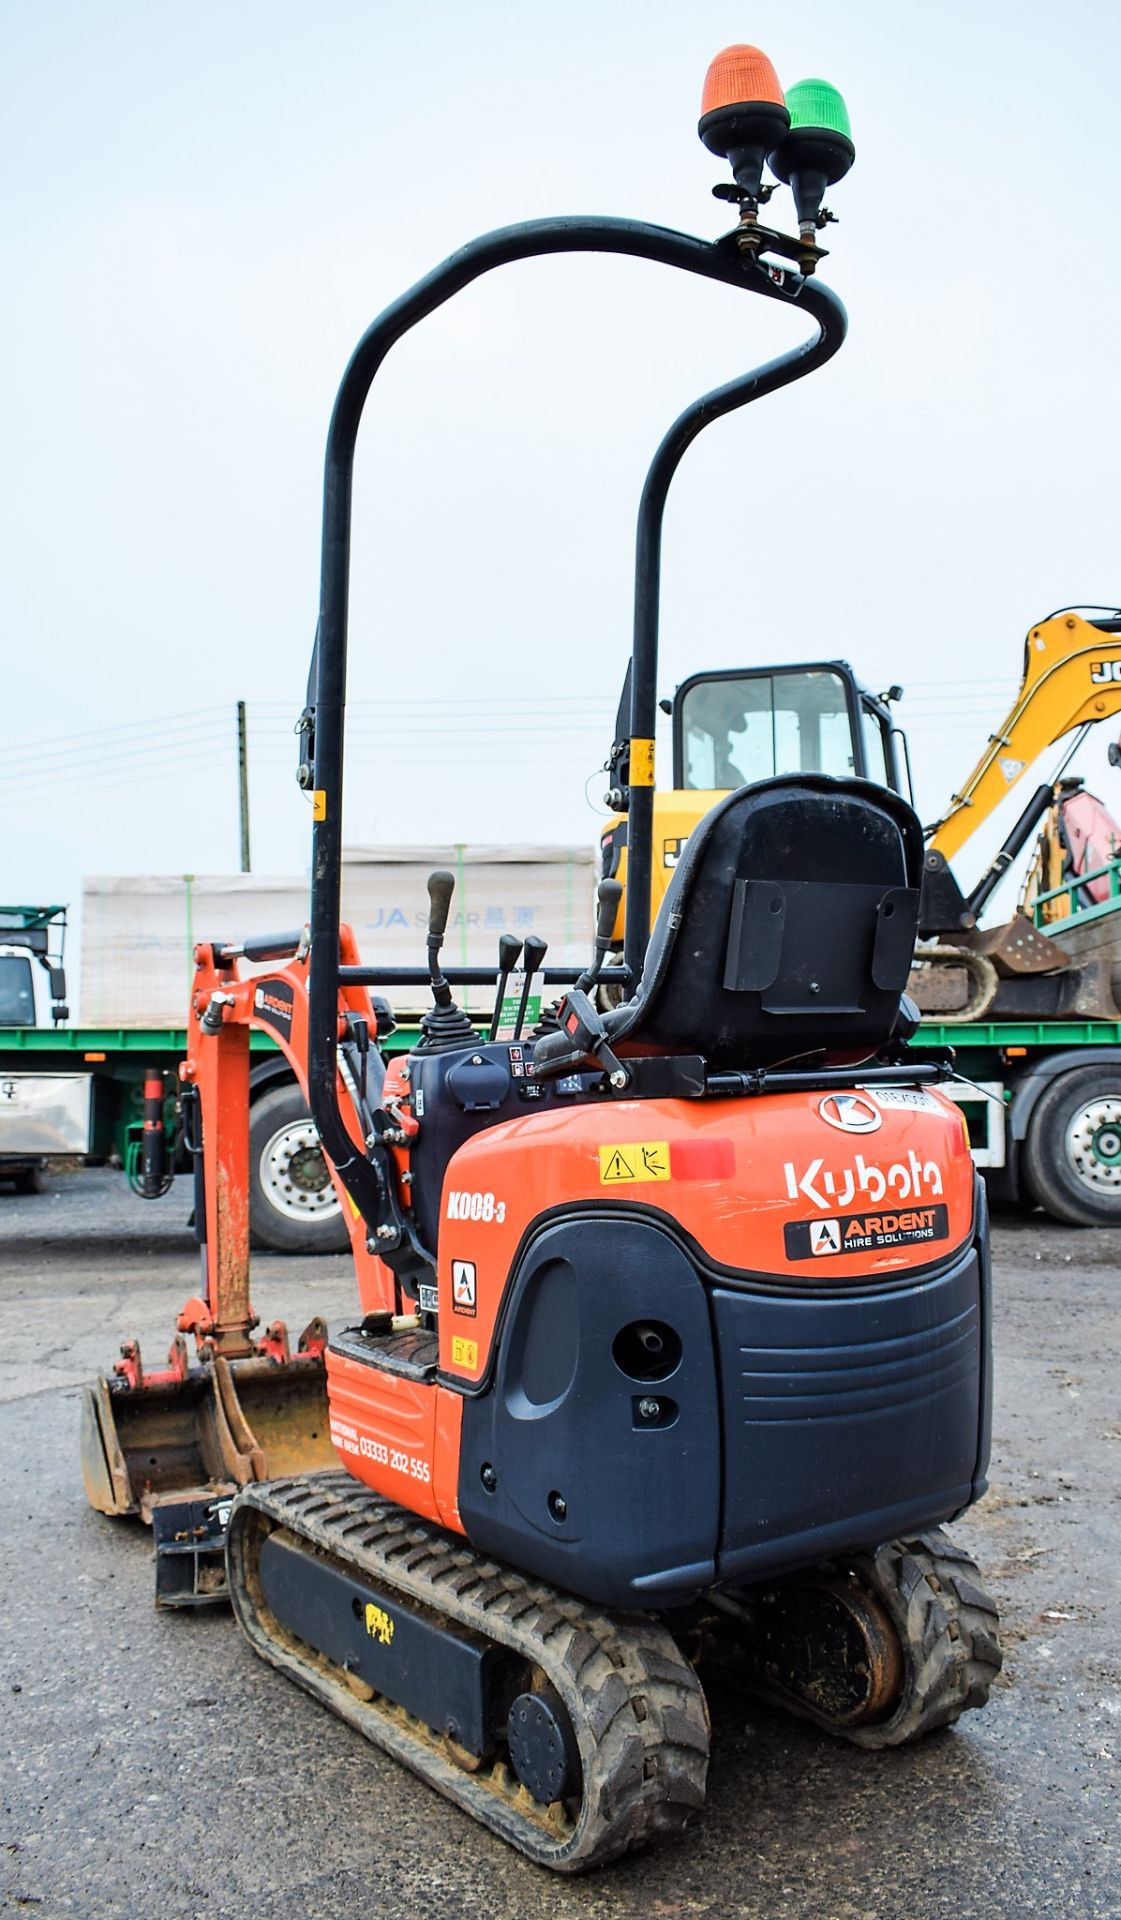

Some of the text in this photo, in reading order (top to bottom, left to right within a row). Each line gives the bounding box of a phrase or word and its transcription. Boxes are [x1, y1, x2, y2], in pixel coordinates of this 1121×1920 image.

[366, 908, 409, 929] JA
[264, 993, 293, 1014] ARDENT
[784, 1150, 943, 1209] Kubota
[447, 1191, 506, 1224] K008-3
[845, 1210, 936, 1239] ARDENT
[844, 1237, 873, 1249] HIRE
[360, 1436, 389, 1465] 03333
[389, 1449, 410, 1475] 202
[410, 1457, 431, 1483] 555
